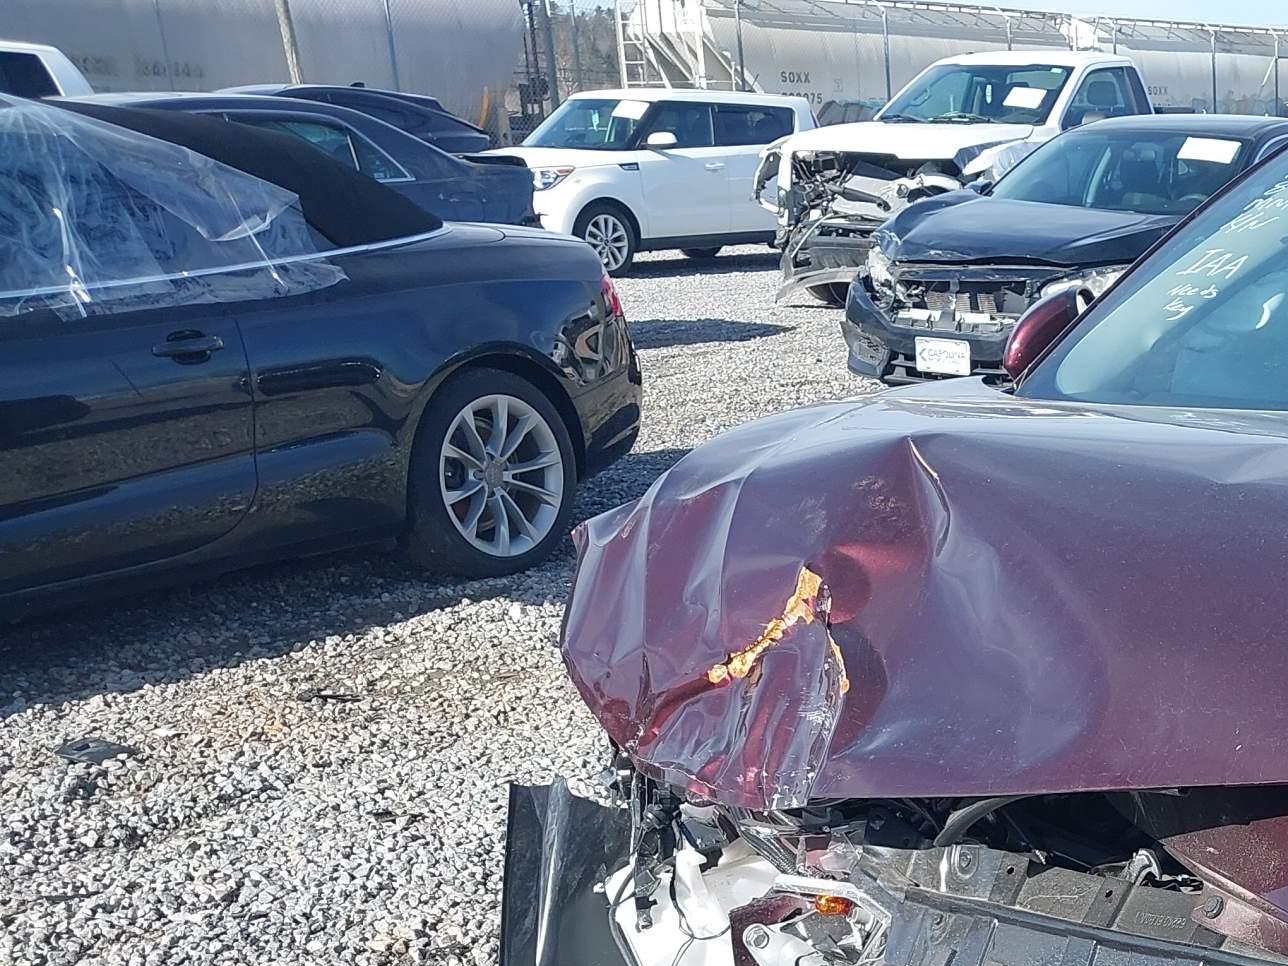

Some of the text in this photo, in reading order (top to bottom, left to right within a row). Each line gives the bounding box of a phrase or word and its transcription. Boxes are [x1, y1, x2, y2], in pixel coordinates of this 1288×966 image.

[780, 71, 811, 83] SOXX
[1147, 86, 1169, 96] SOXX
[1176, 249, 1248, 279] IAA
